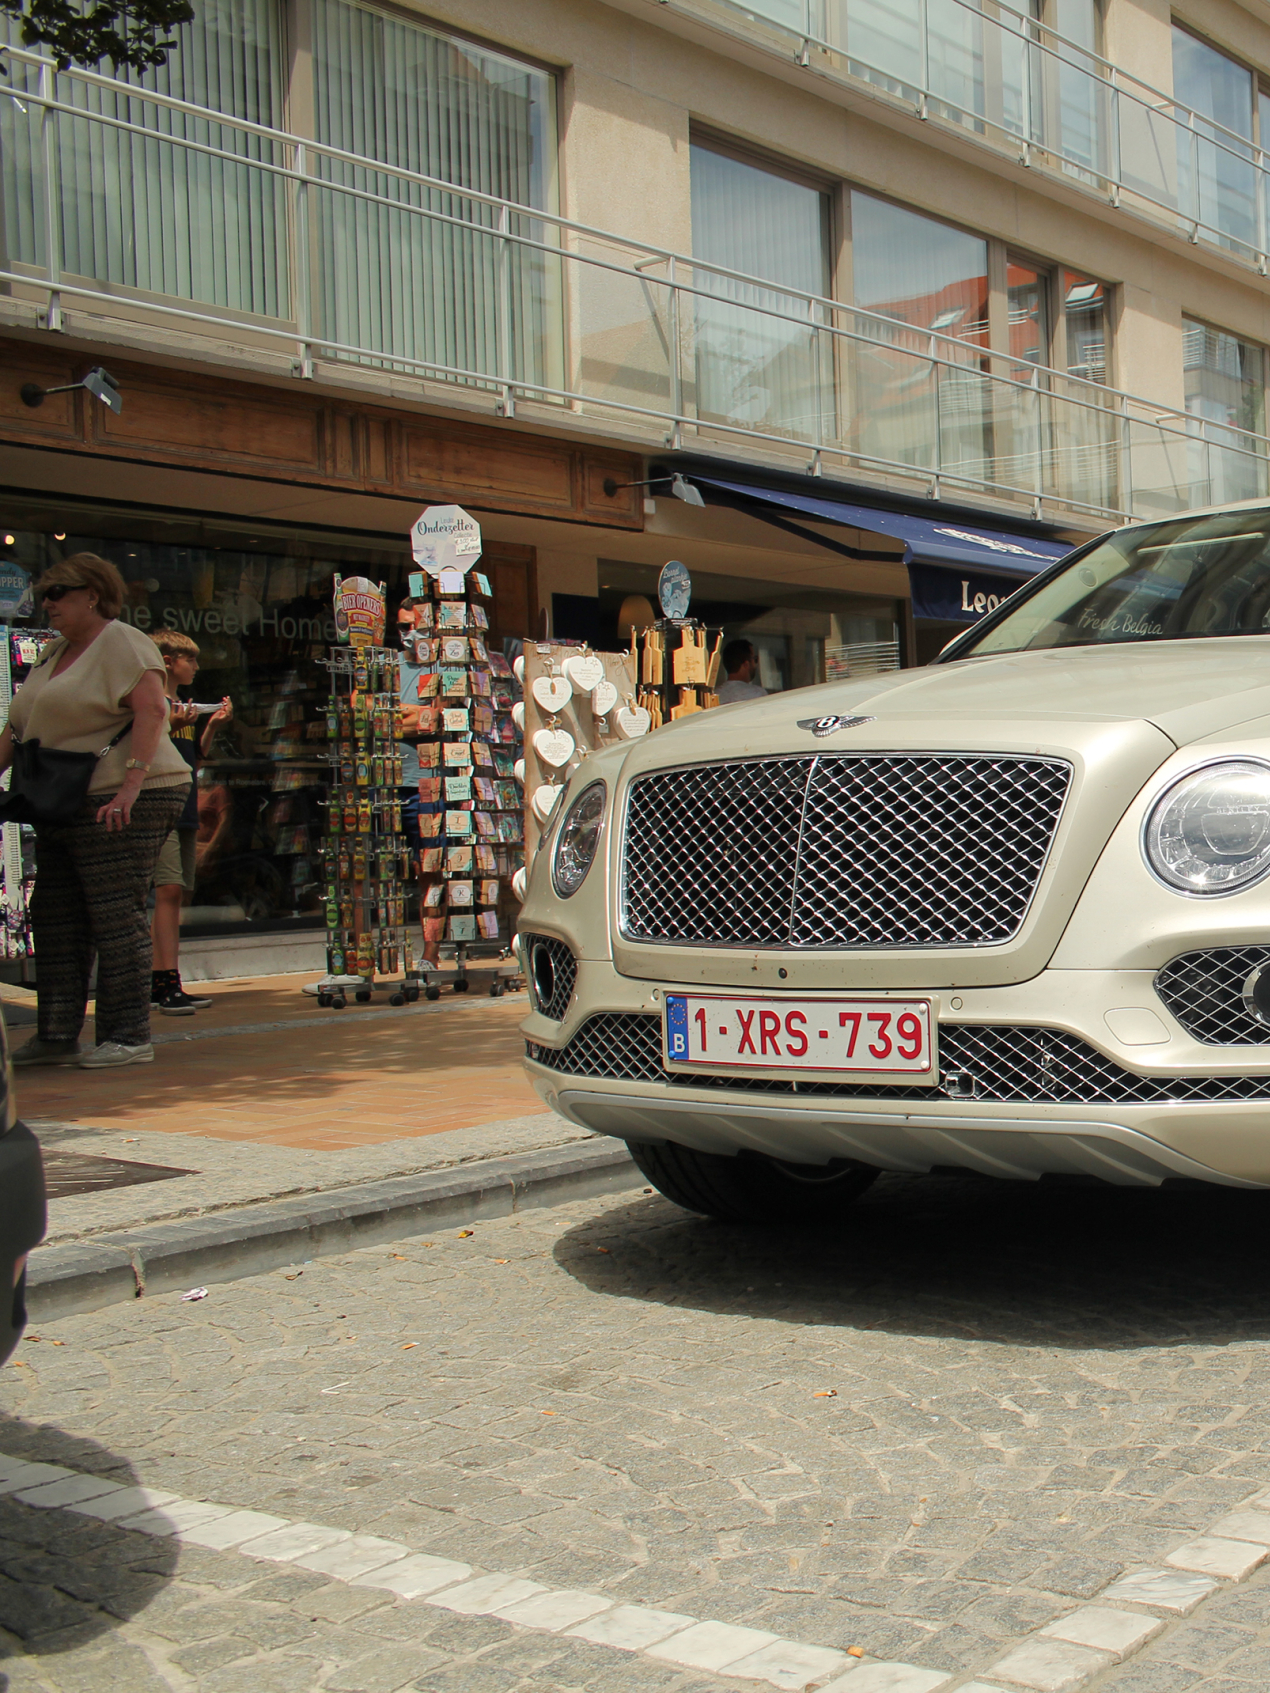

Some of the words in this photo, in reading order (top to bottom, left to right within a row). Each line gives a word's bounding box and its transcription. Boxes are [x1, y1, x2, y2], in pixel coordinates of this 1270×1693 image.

[417, 519, 474, 536] Onderzetter
[0, 576, 24, 589] PPER
[343, 595, 357, 610] BIER
[357, 594, 381, 616] OPENERS
[961, 580, 1008, 613] Leo
[163, 607, 250, 635] sweet
[259, 608, 337, 641] Home
[817, 716, 837, 728] B
[673, 1033, 686, 1053] B
[694, 1007, 923, 1060] 1-XRS-739
